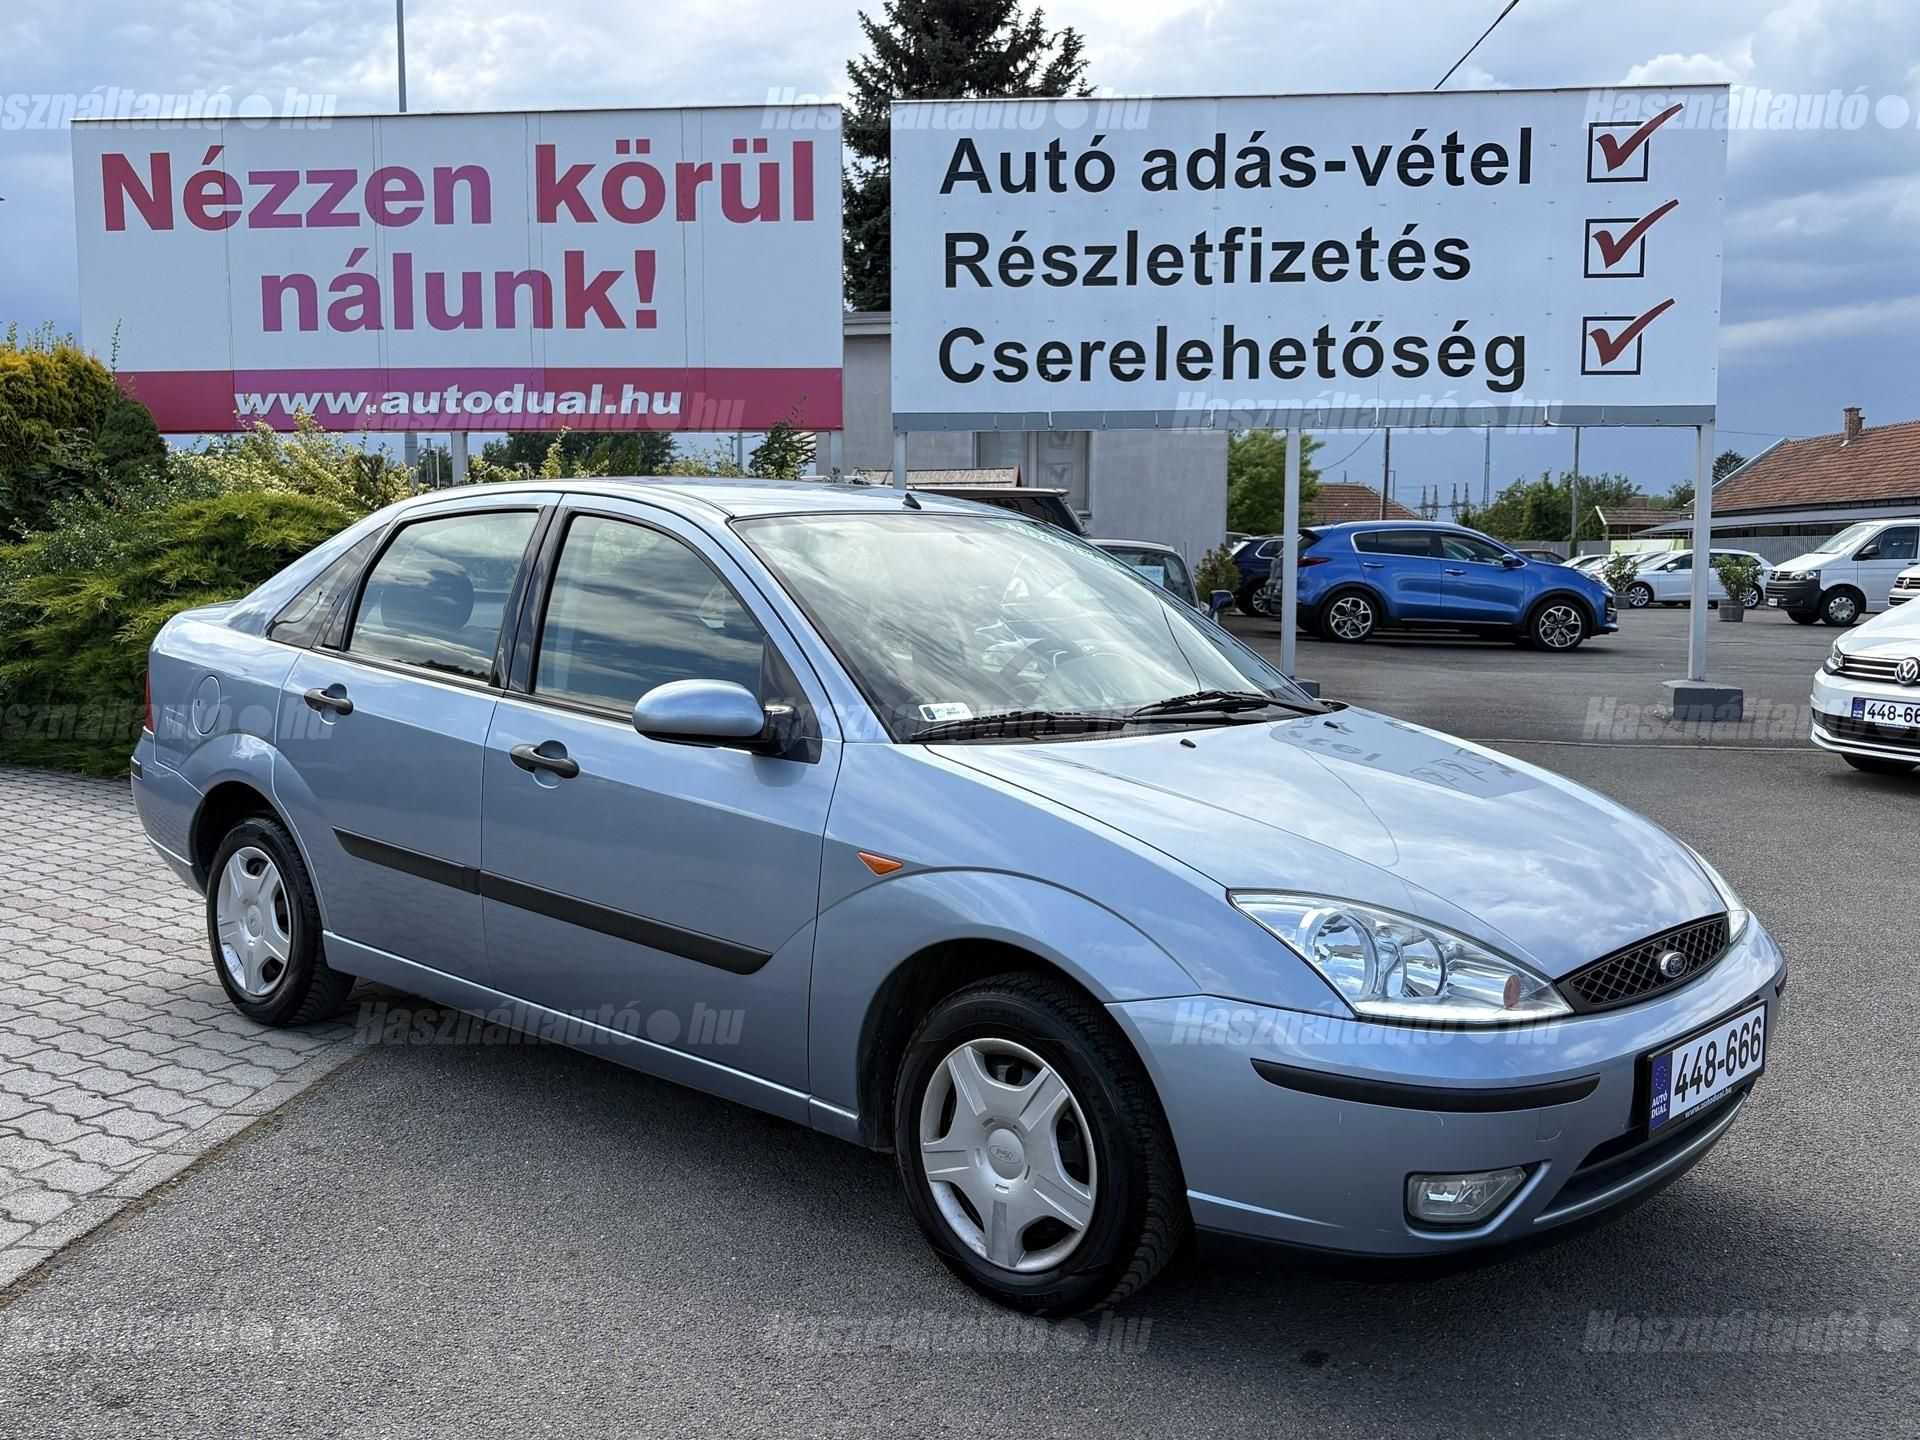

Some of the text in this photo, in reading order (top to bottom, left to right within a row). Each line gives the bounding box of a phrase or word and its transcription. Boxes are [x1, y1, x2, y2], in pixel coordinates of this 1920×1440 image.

[100, 137, 815, 232] Nézzen körül
[939, 126, 1532, 194] Autó adás-vétel
[262, 247, 657, 332] nálunk!
[944, 222, 1471, 288] Részletfizetés
[938, 319, 1526, 393] Cserelehetőség
[235, 383, 682, 416] www.autodual.hu
[1674, 1015, 1762, 1103] 448-666
